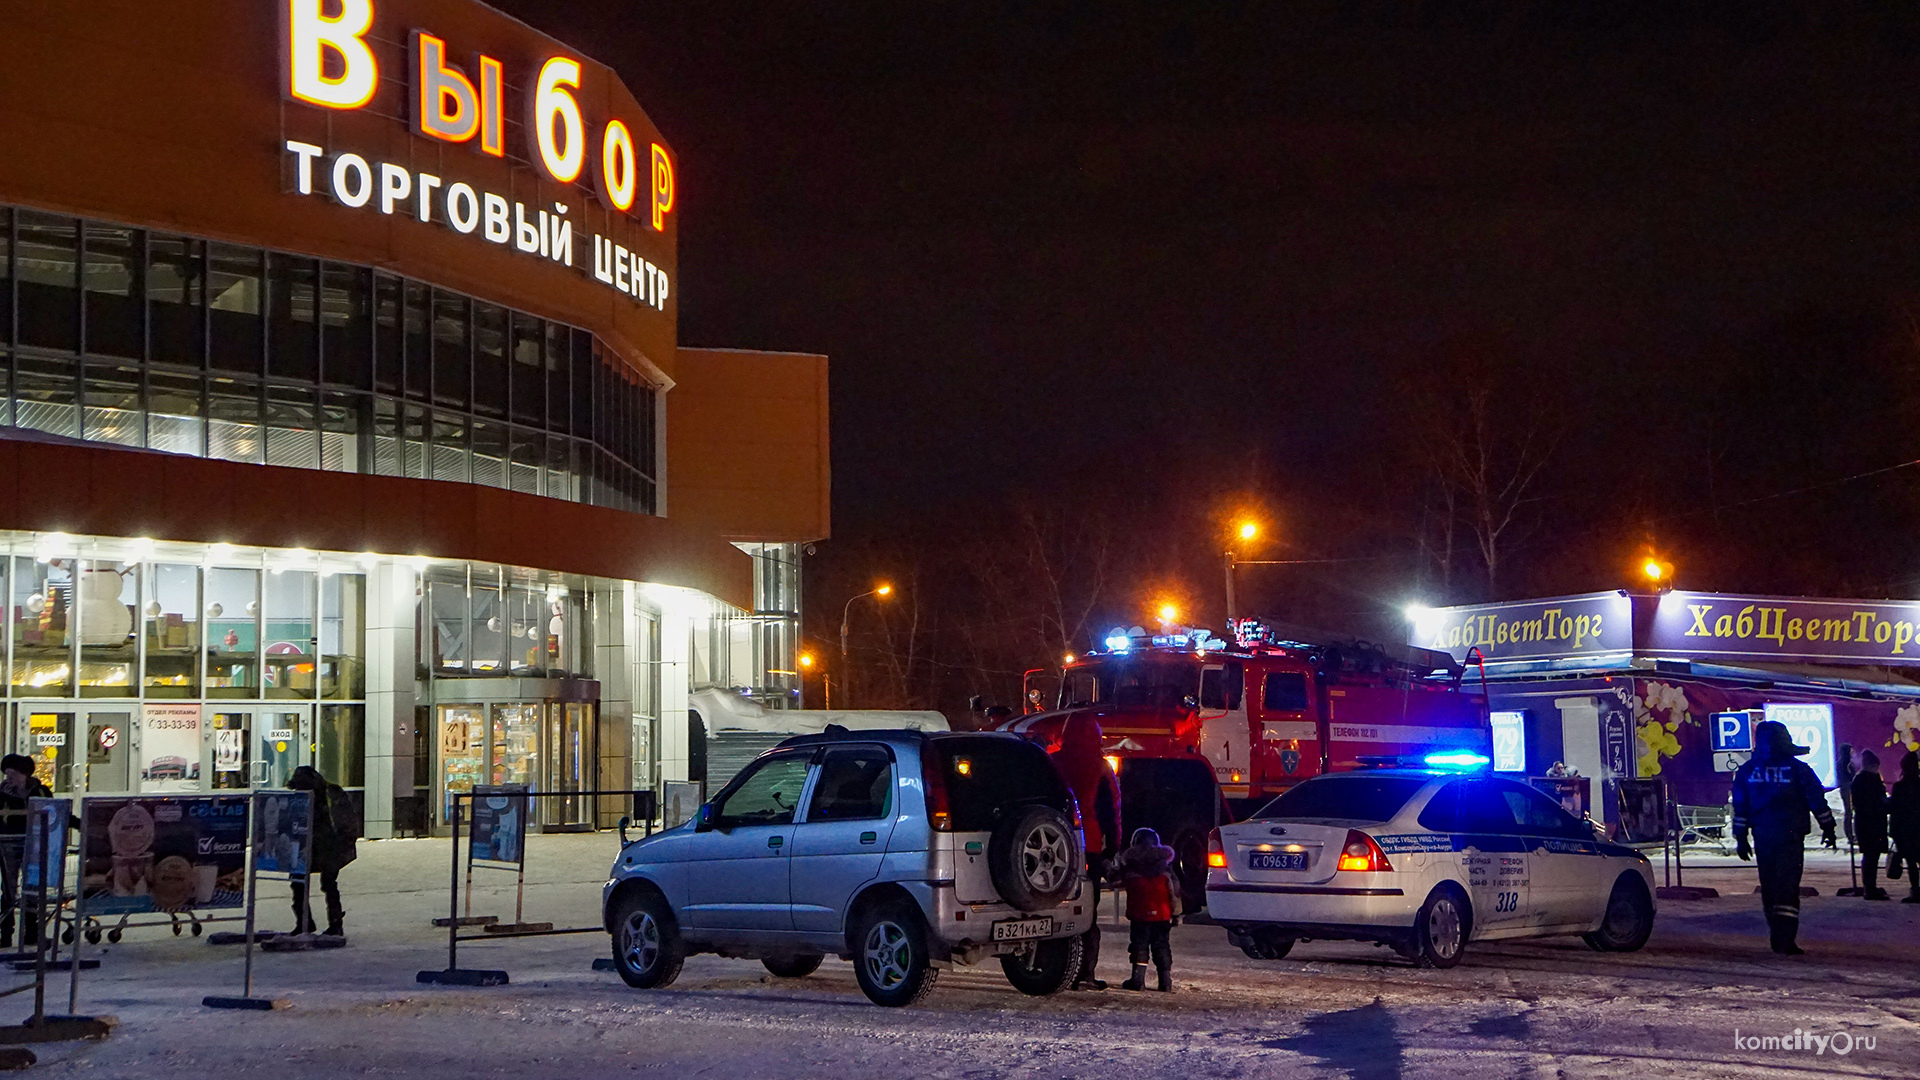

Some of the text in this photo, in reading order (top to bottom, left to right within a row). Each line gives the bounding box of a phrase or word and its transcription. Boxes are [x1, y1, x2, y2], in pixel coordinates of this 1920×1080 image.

[286, 140, 669, 312] ТОРГОВЫЙ ЦЕНТР
[1431, 608, 1603, 651] ХабЦветТорг
[156, 719, 197, 730] 33-33-39
[1333, 727, 1360, 737] ТЕЛЕФОН
[1718, 716, 1741, 747] P
[39, 735, 63, 744] ВХОД
[1496, 727, 1519, 754] 79
[1223, 740, 1230, 761] 1
[1614, 745, 1620, 757] 9
[1613, 760, 1623, 771] 20
[1748, 766, 1791, 783] ДПС
[1543, 839, 1584, 851] ПОЛИЦИЯ
[1262, 855, 1288, 868] 0963
[1293, 855, 1304, 865] 27
[1462, 857, 1492, 865] ДЕЖУРНАЯ
[1500, 858, 1524, 866] ТЕЛЕФОН
[1468, 867, 1486, 875] ЧАСТЬ
[1499, 867, 1524, 876] ДОВЕРИЯ
[1495, 892, 1519, 913] 318
